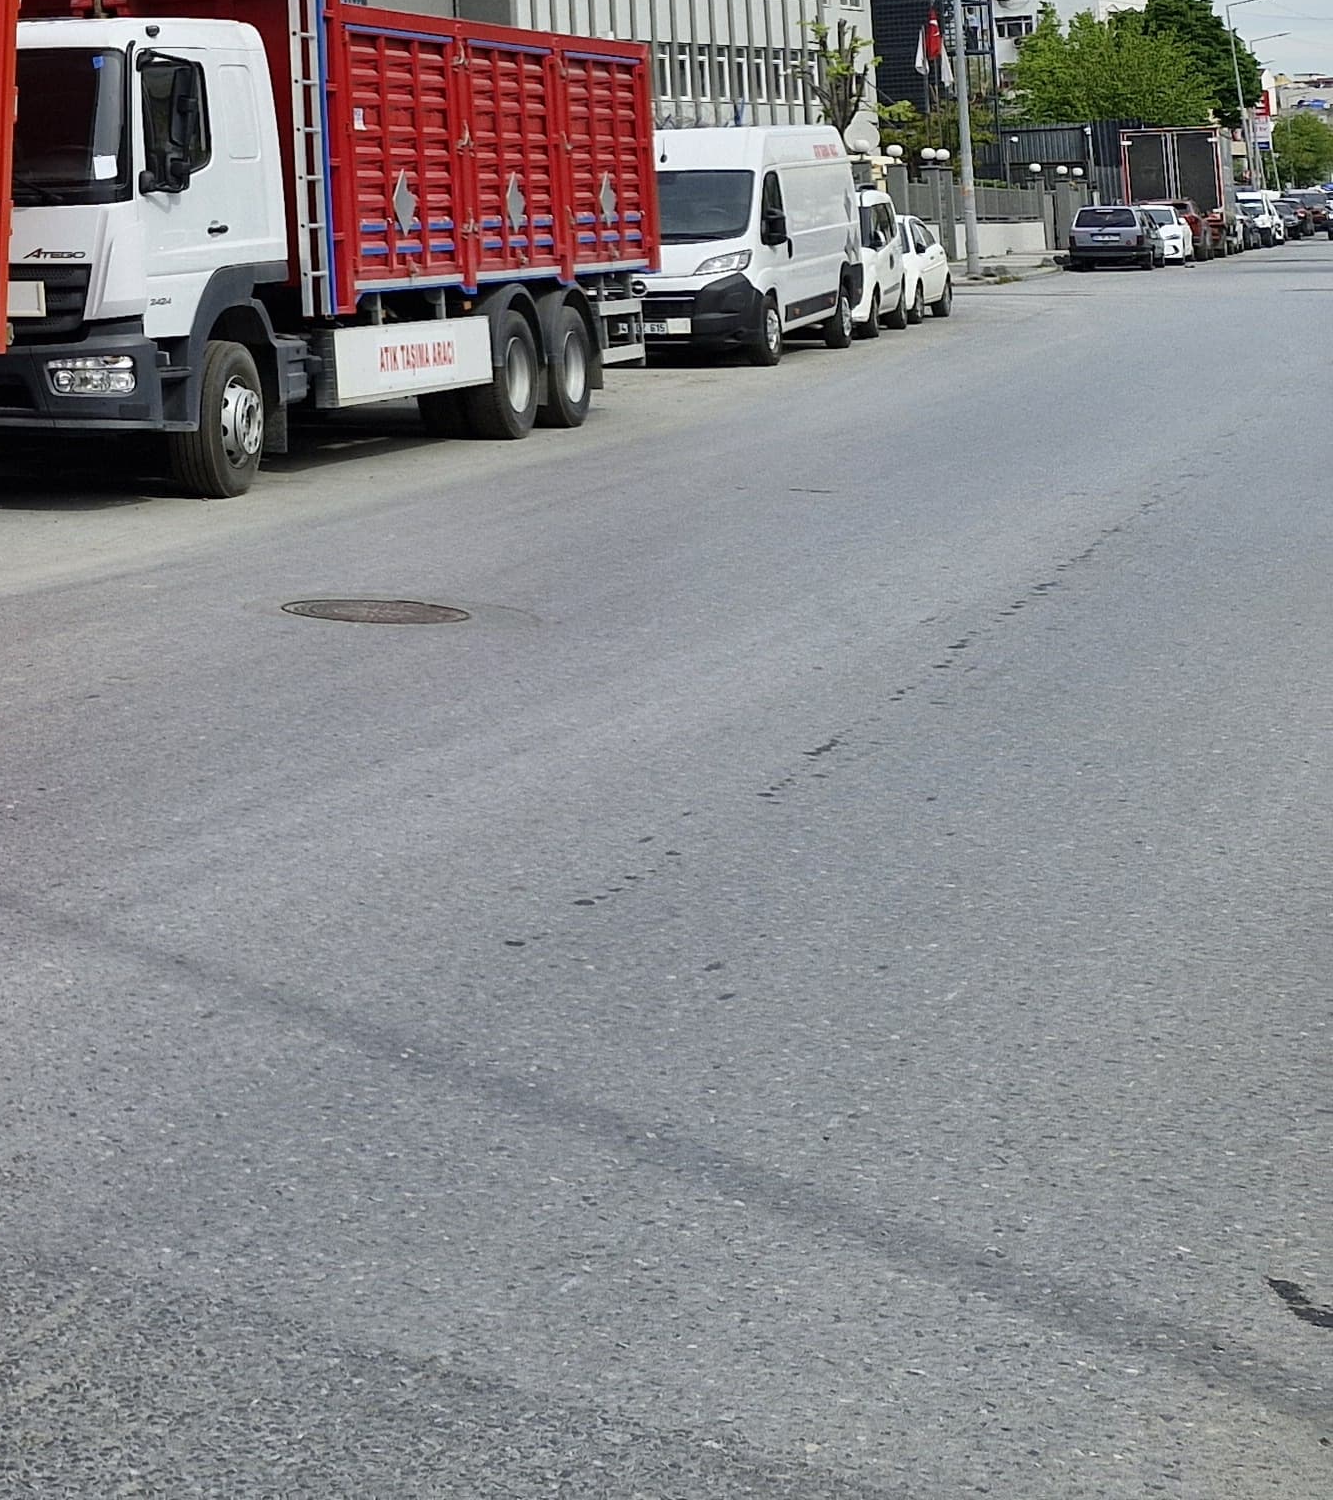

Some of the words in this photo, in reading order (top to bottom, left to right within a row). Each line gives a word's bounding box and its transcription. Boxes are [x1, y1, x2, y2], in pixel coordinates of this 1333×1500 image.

[650, 323, 666, 333] 615
[380, 345, 399, 372] ATIK
[400, 343, 430, 376] TAŞIMA
[432, 340, 455, 367] ARACI
